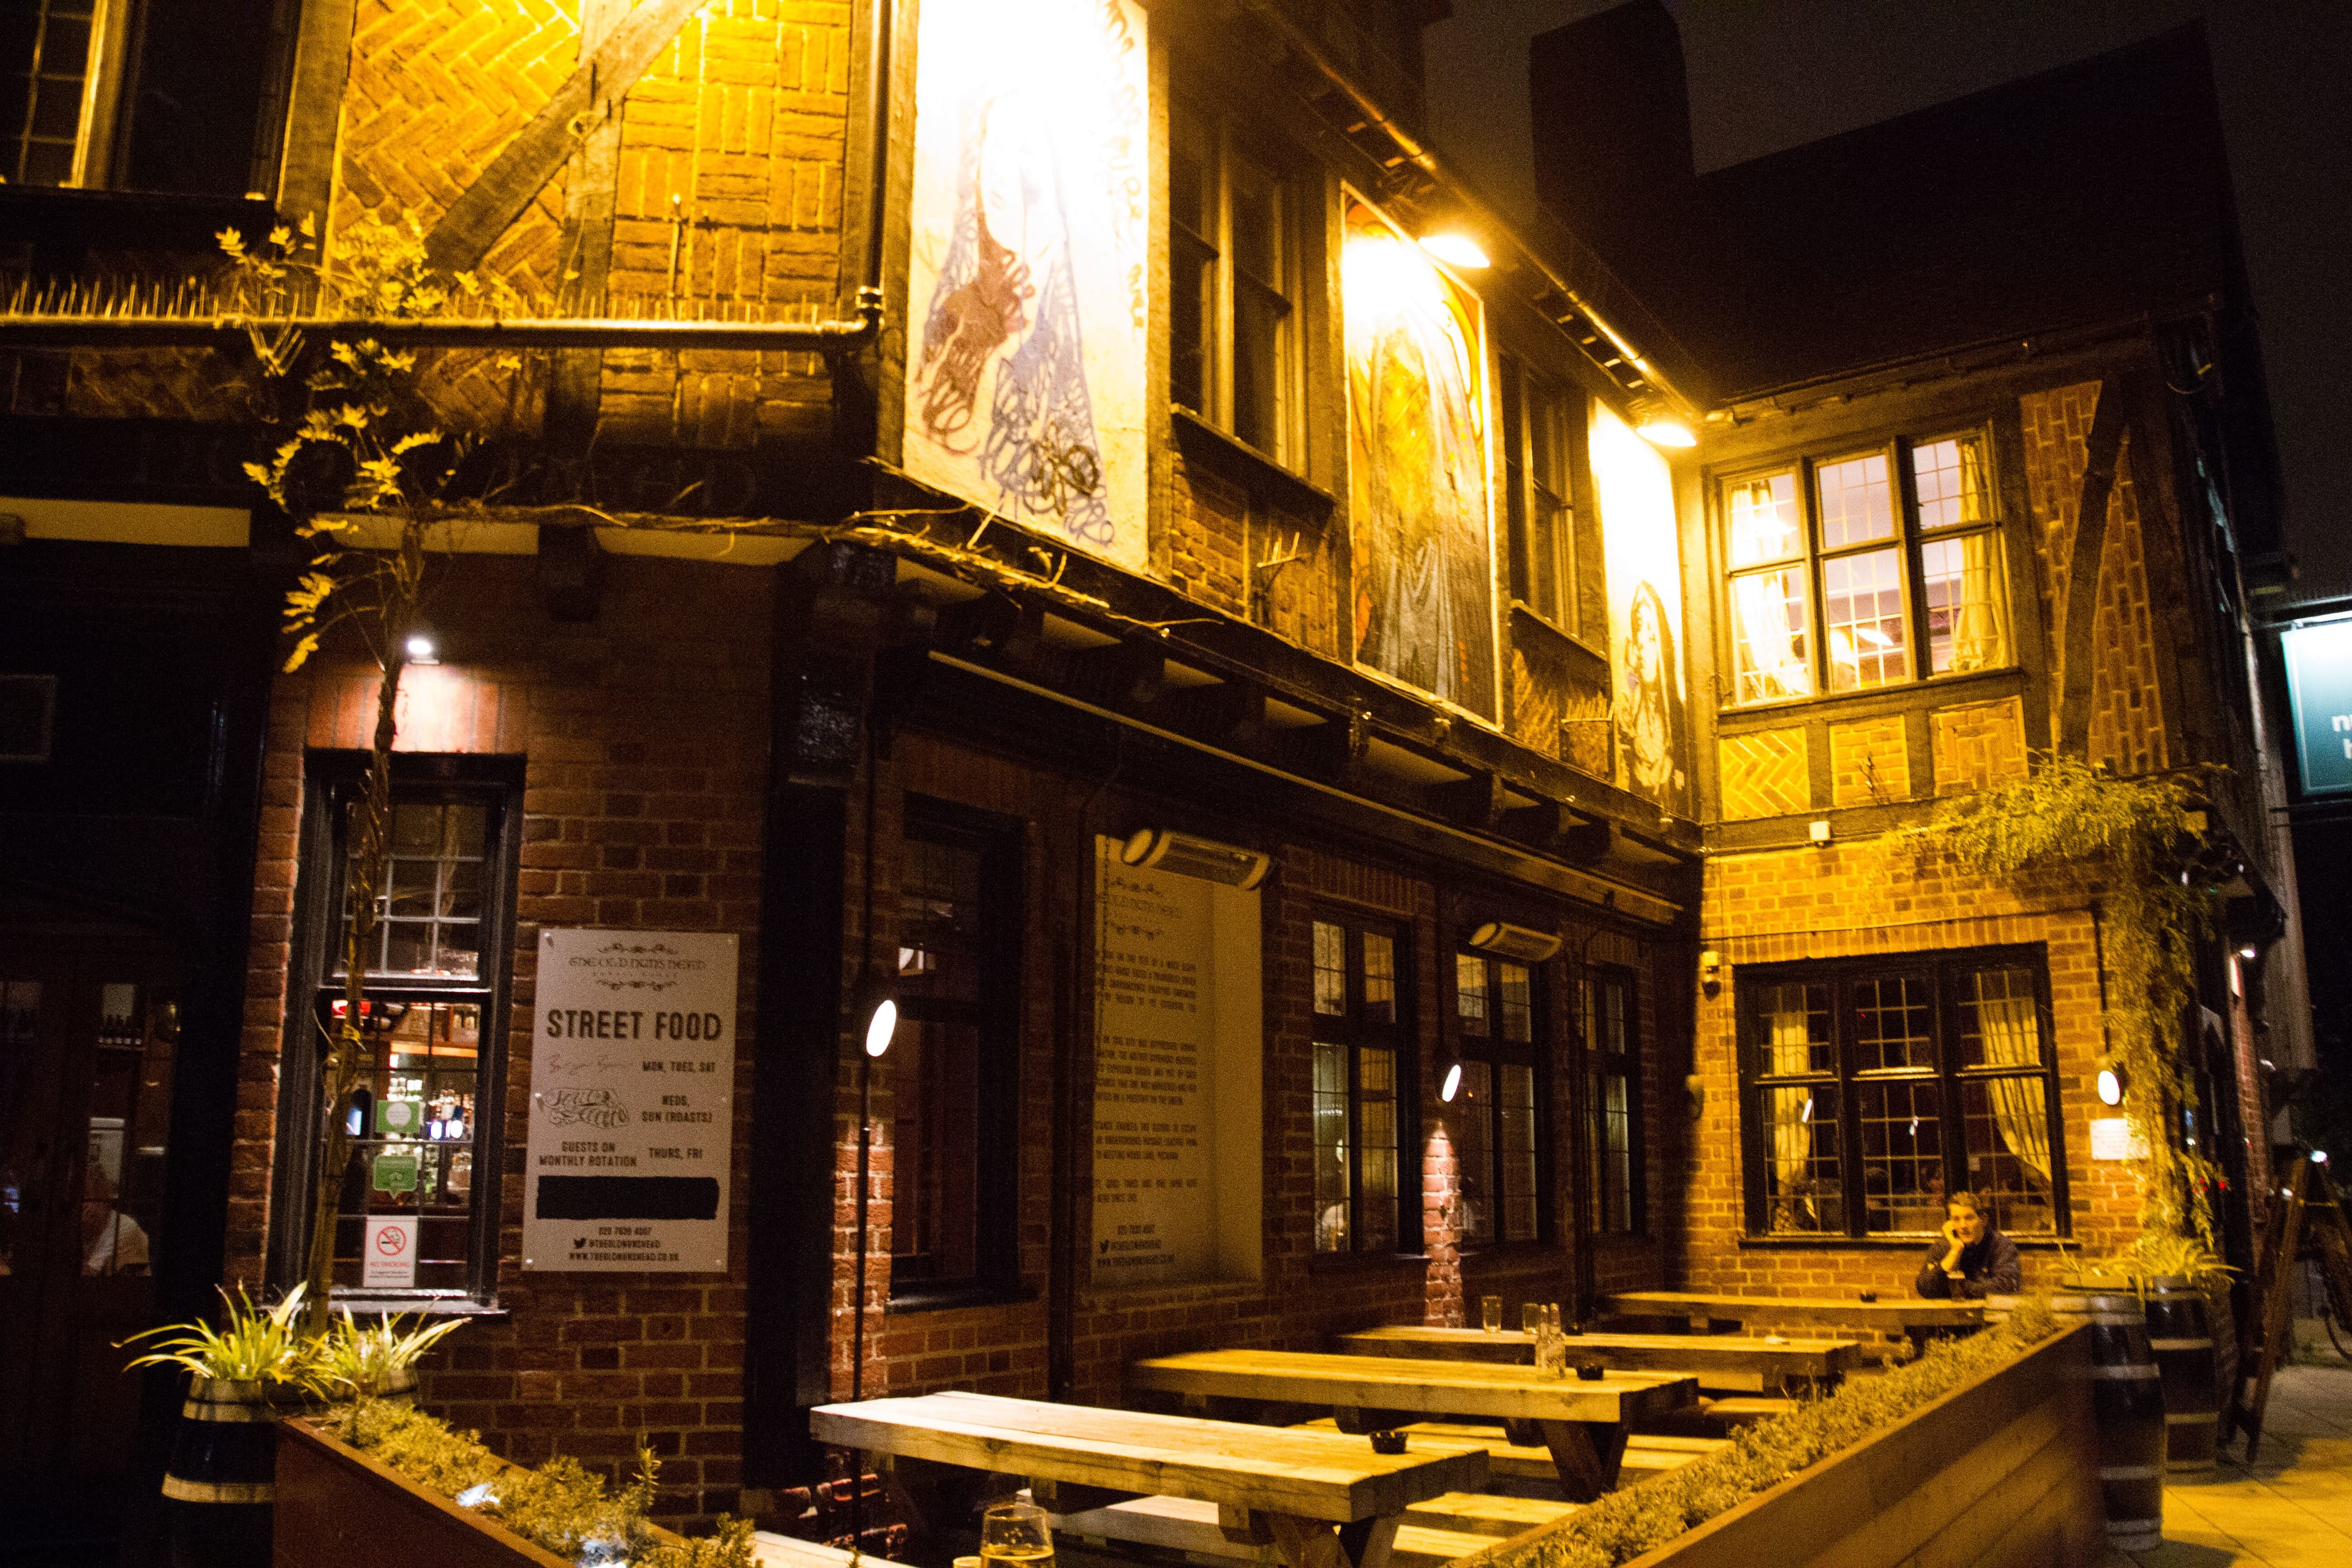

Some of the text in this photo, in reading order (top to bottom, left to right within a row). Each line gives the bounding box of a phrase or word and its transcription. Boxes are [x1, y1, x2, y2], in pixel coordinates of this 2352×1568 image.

[547, 1009, 723, 1041] STREET FOOD
[642, 1061, 666, 1073] MON,
[670, 1061, 696, 1074] TUES,
[699, 1061, 716, 1072] SAT
[642, 1111, 713, 1123] SUN (ROASTS)
[561, 1141, 616, 1153] GUESTS ON
[649, 1147, 704, 1160] THURS, FRI
[539, 1155, 638, 1167] MONTHLY ROTATION
